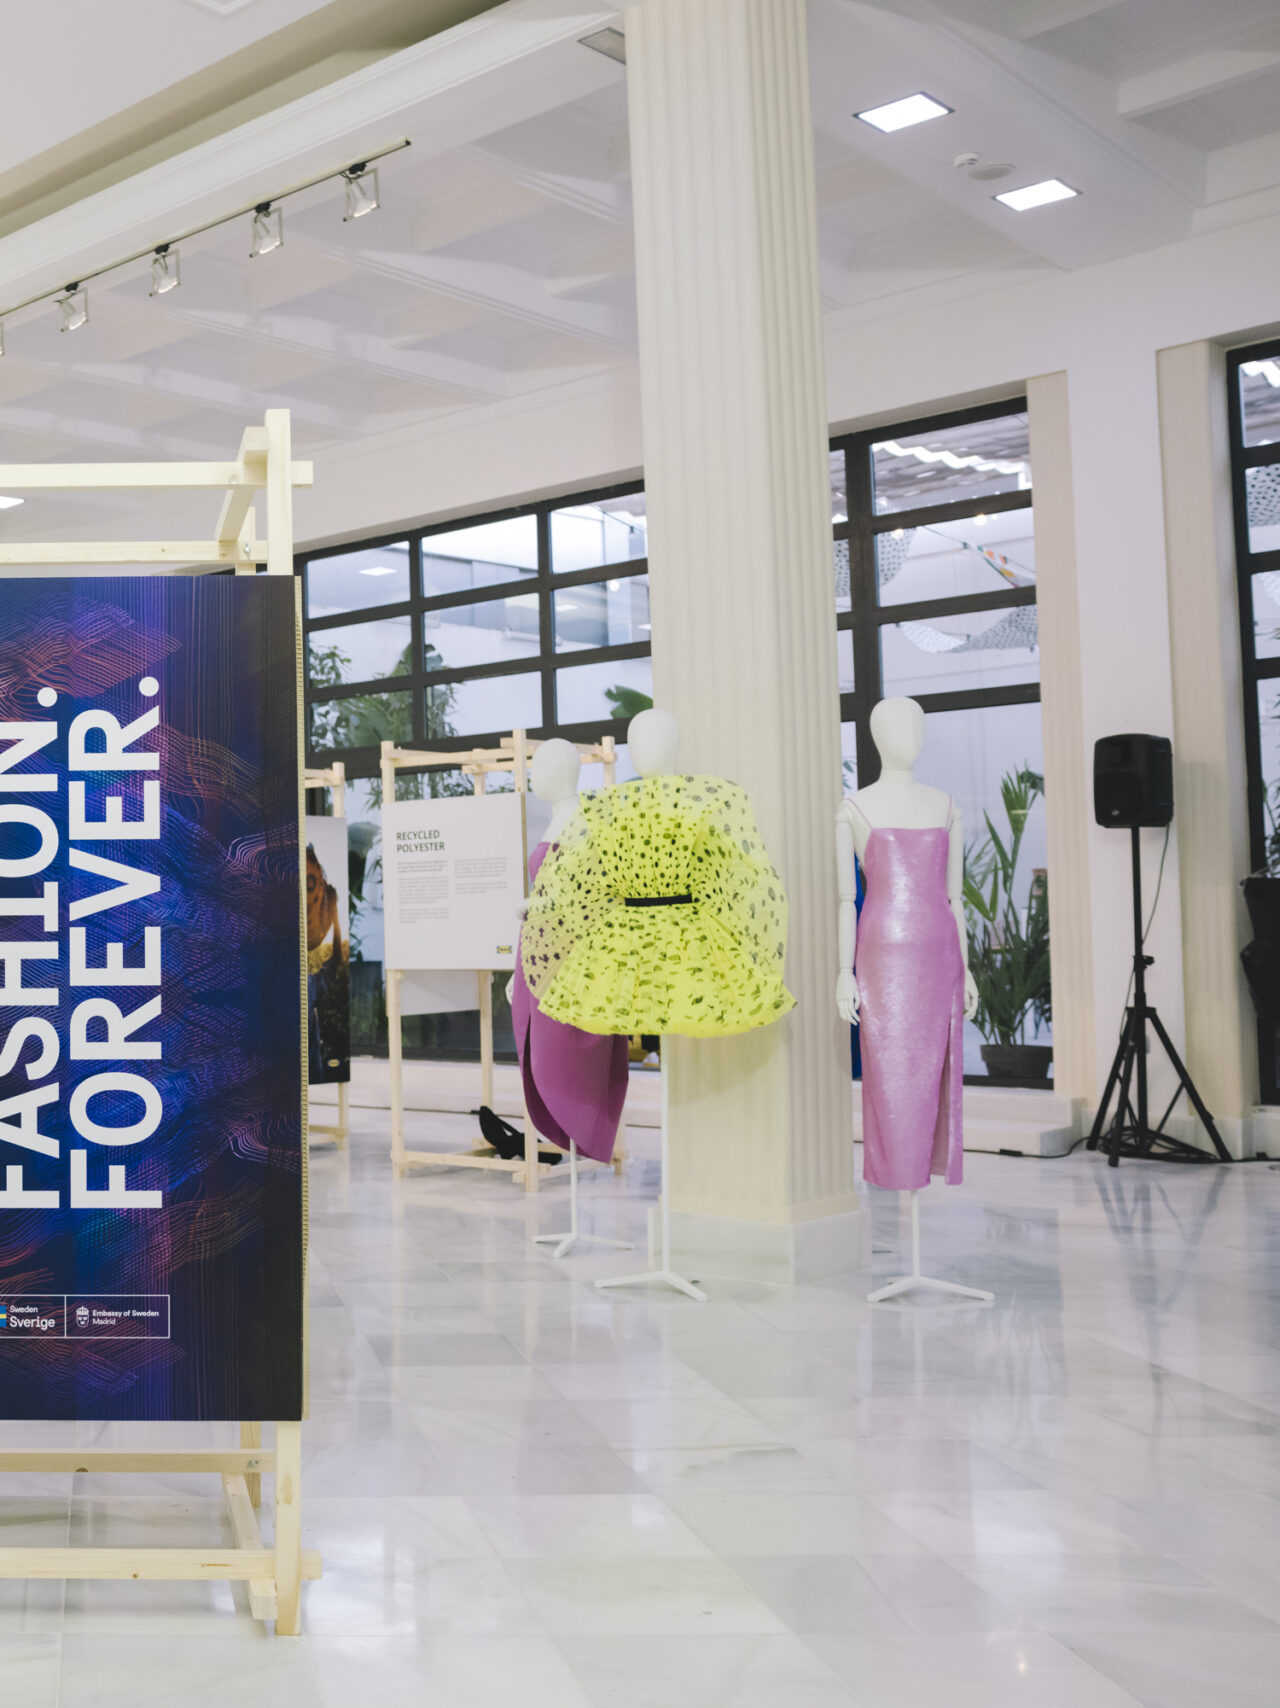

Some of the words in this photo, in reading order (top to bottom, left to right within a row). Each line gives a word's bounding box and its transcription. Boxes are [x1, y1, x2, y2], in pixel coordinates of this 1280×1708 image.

[397, 830, 440, 840] RECYCLED
[397, 842, 445, 852] POLYESTER
[69, 677, 163, 1208] FOREVER.
[10, 1316, 55, 1330] Sverige
